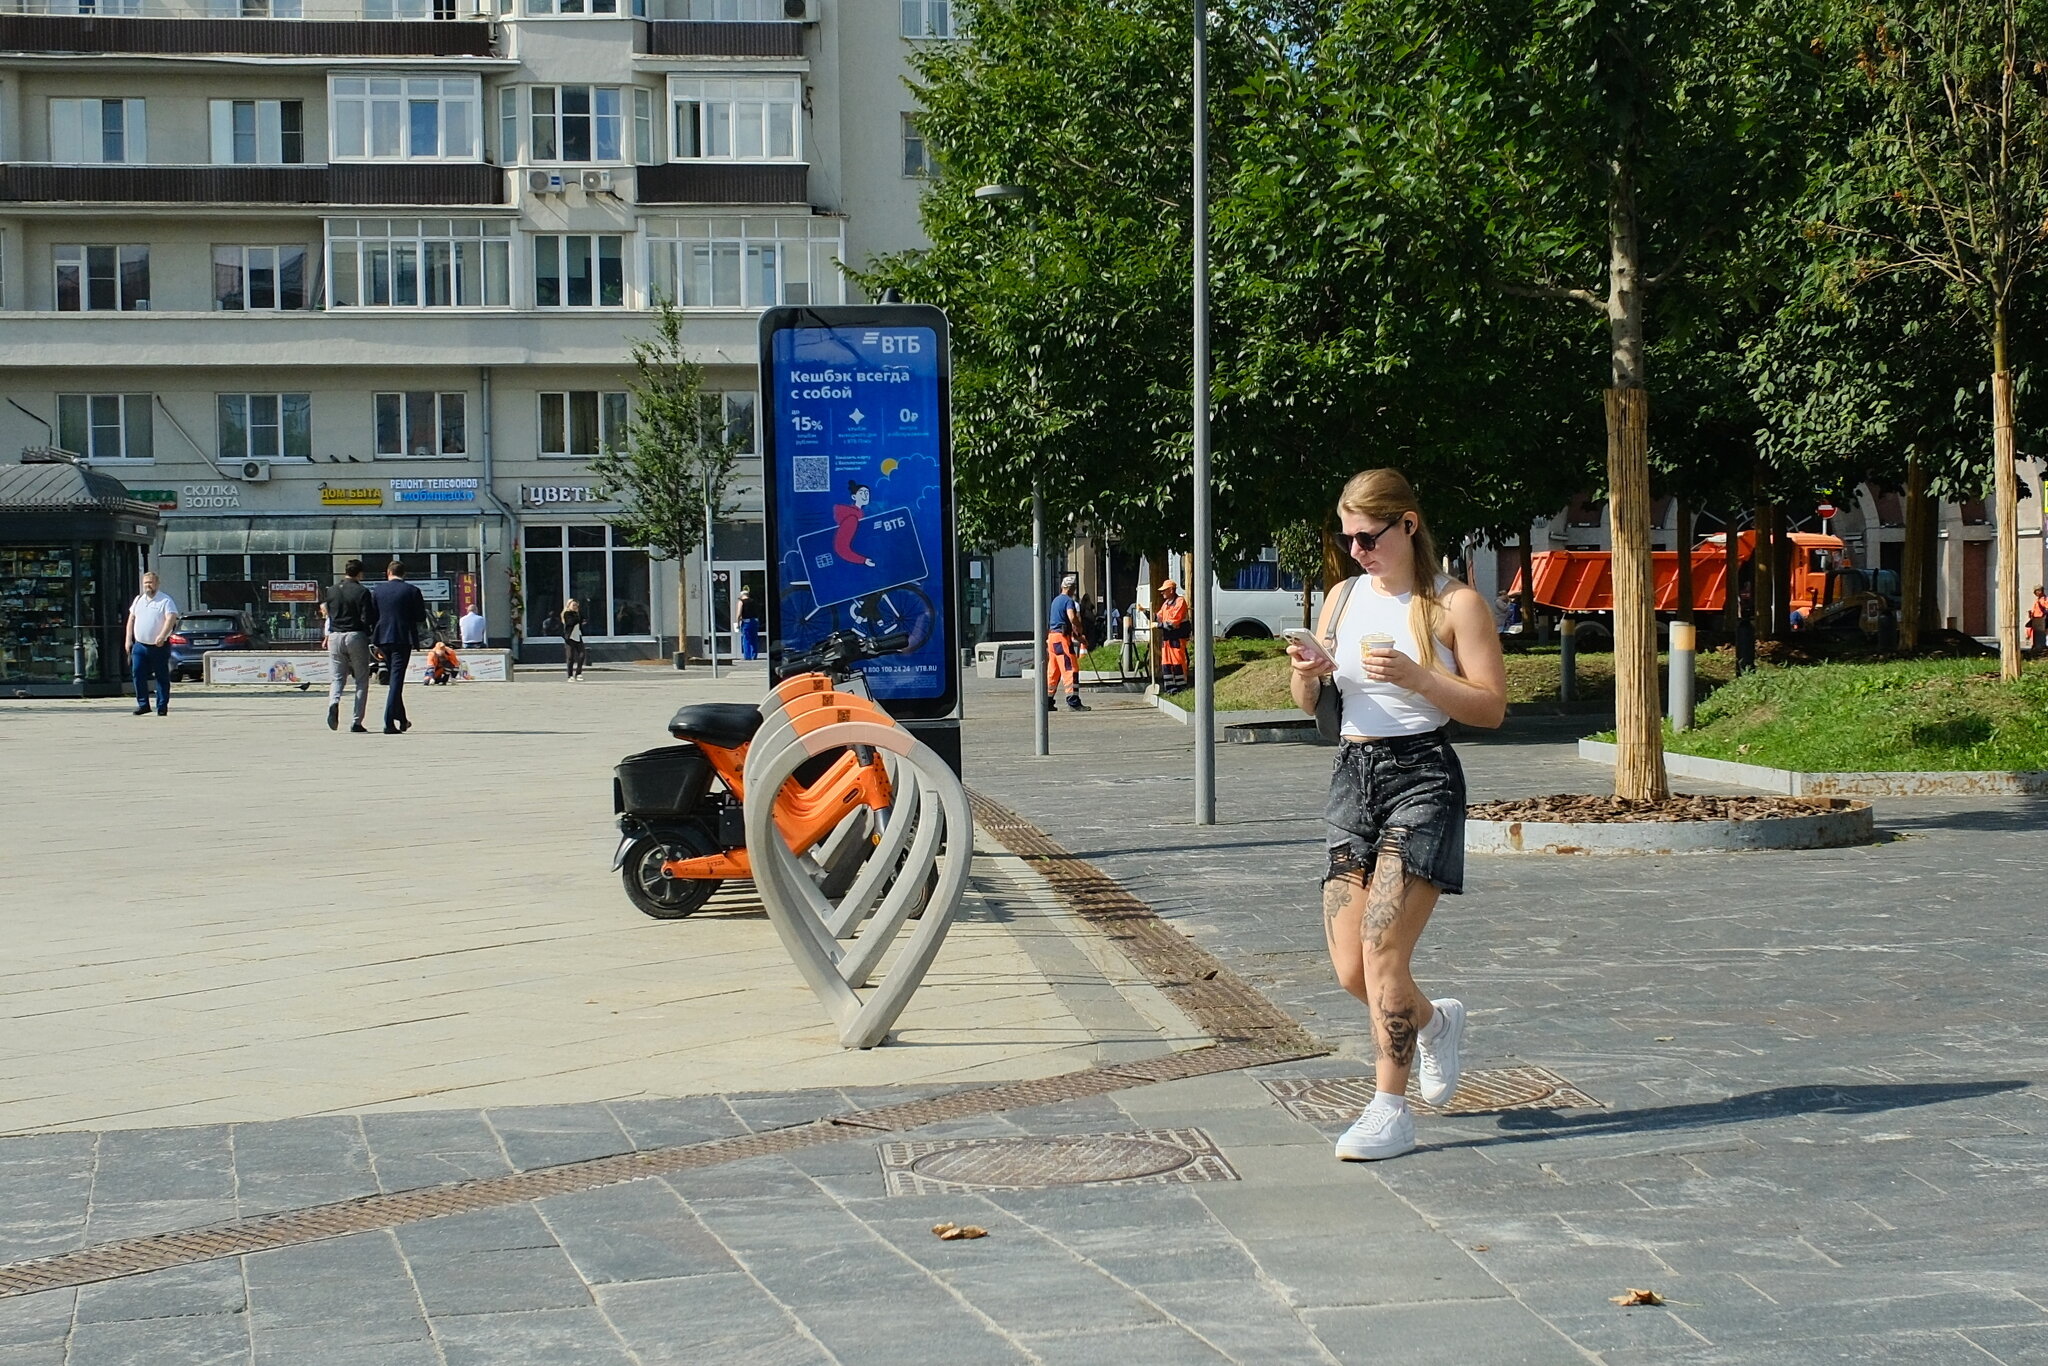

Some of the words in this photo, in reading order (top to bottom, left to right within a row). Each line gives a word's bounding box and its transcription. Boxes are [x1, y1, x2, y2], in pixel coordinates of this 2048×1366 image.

[881, 336, 920, 354] ВТБ
[790, 369, 852, 383] Кешбэк
[856, 371, 910, 384] всегда
[790, 389, 800, 399] с
[802, 385, 853, 399] собой
[791, 416, 824, 431] 15%
[183, 485, 239, 496] СКУПКА
[390, 479, 423, 489] РЕМОНТ
[428, 479, 478, 489] ТЕЛЕФОНОВ
[321, 488, 346, 499] ДОМ
[349, 488, 382, 499] БЫТА
[186, 497, 240, 508] ЗОЛОТА
[883, 517, 905, 531] ВТБ
